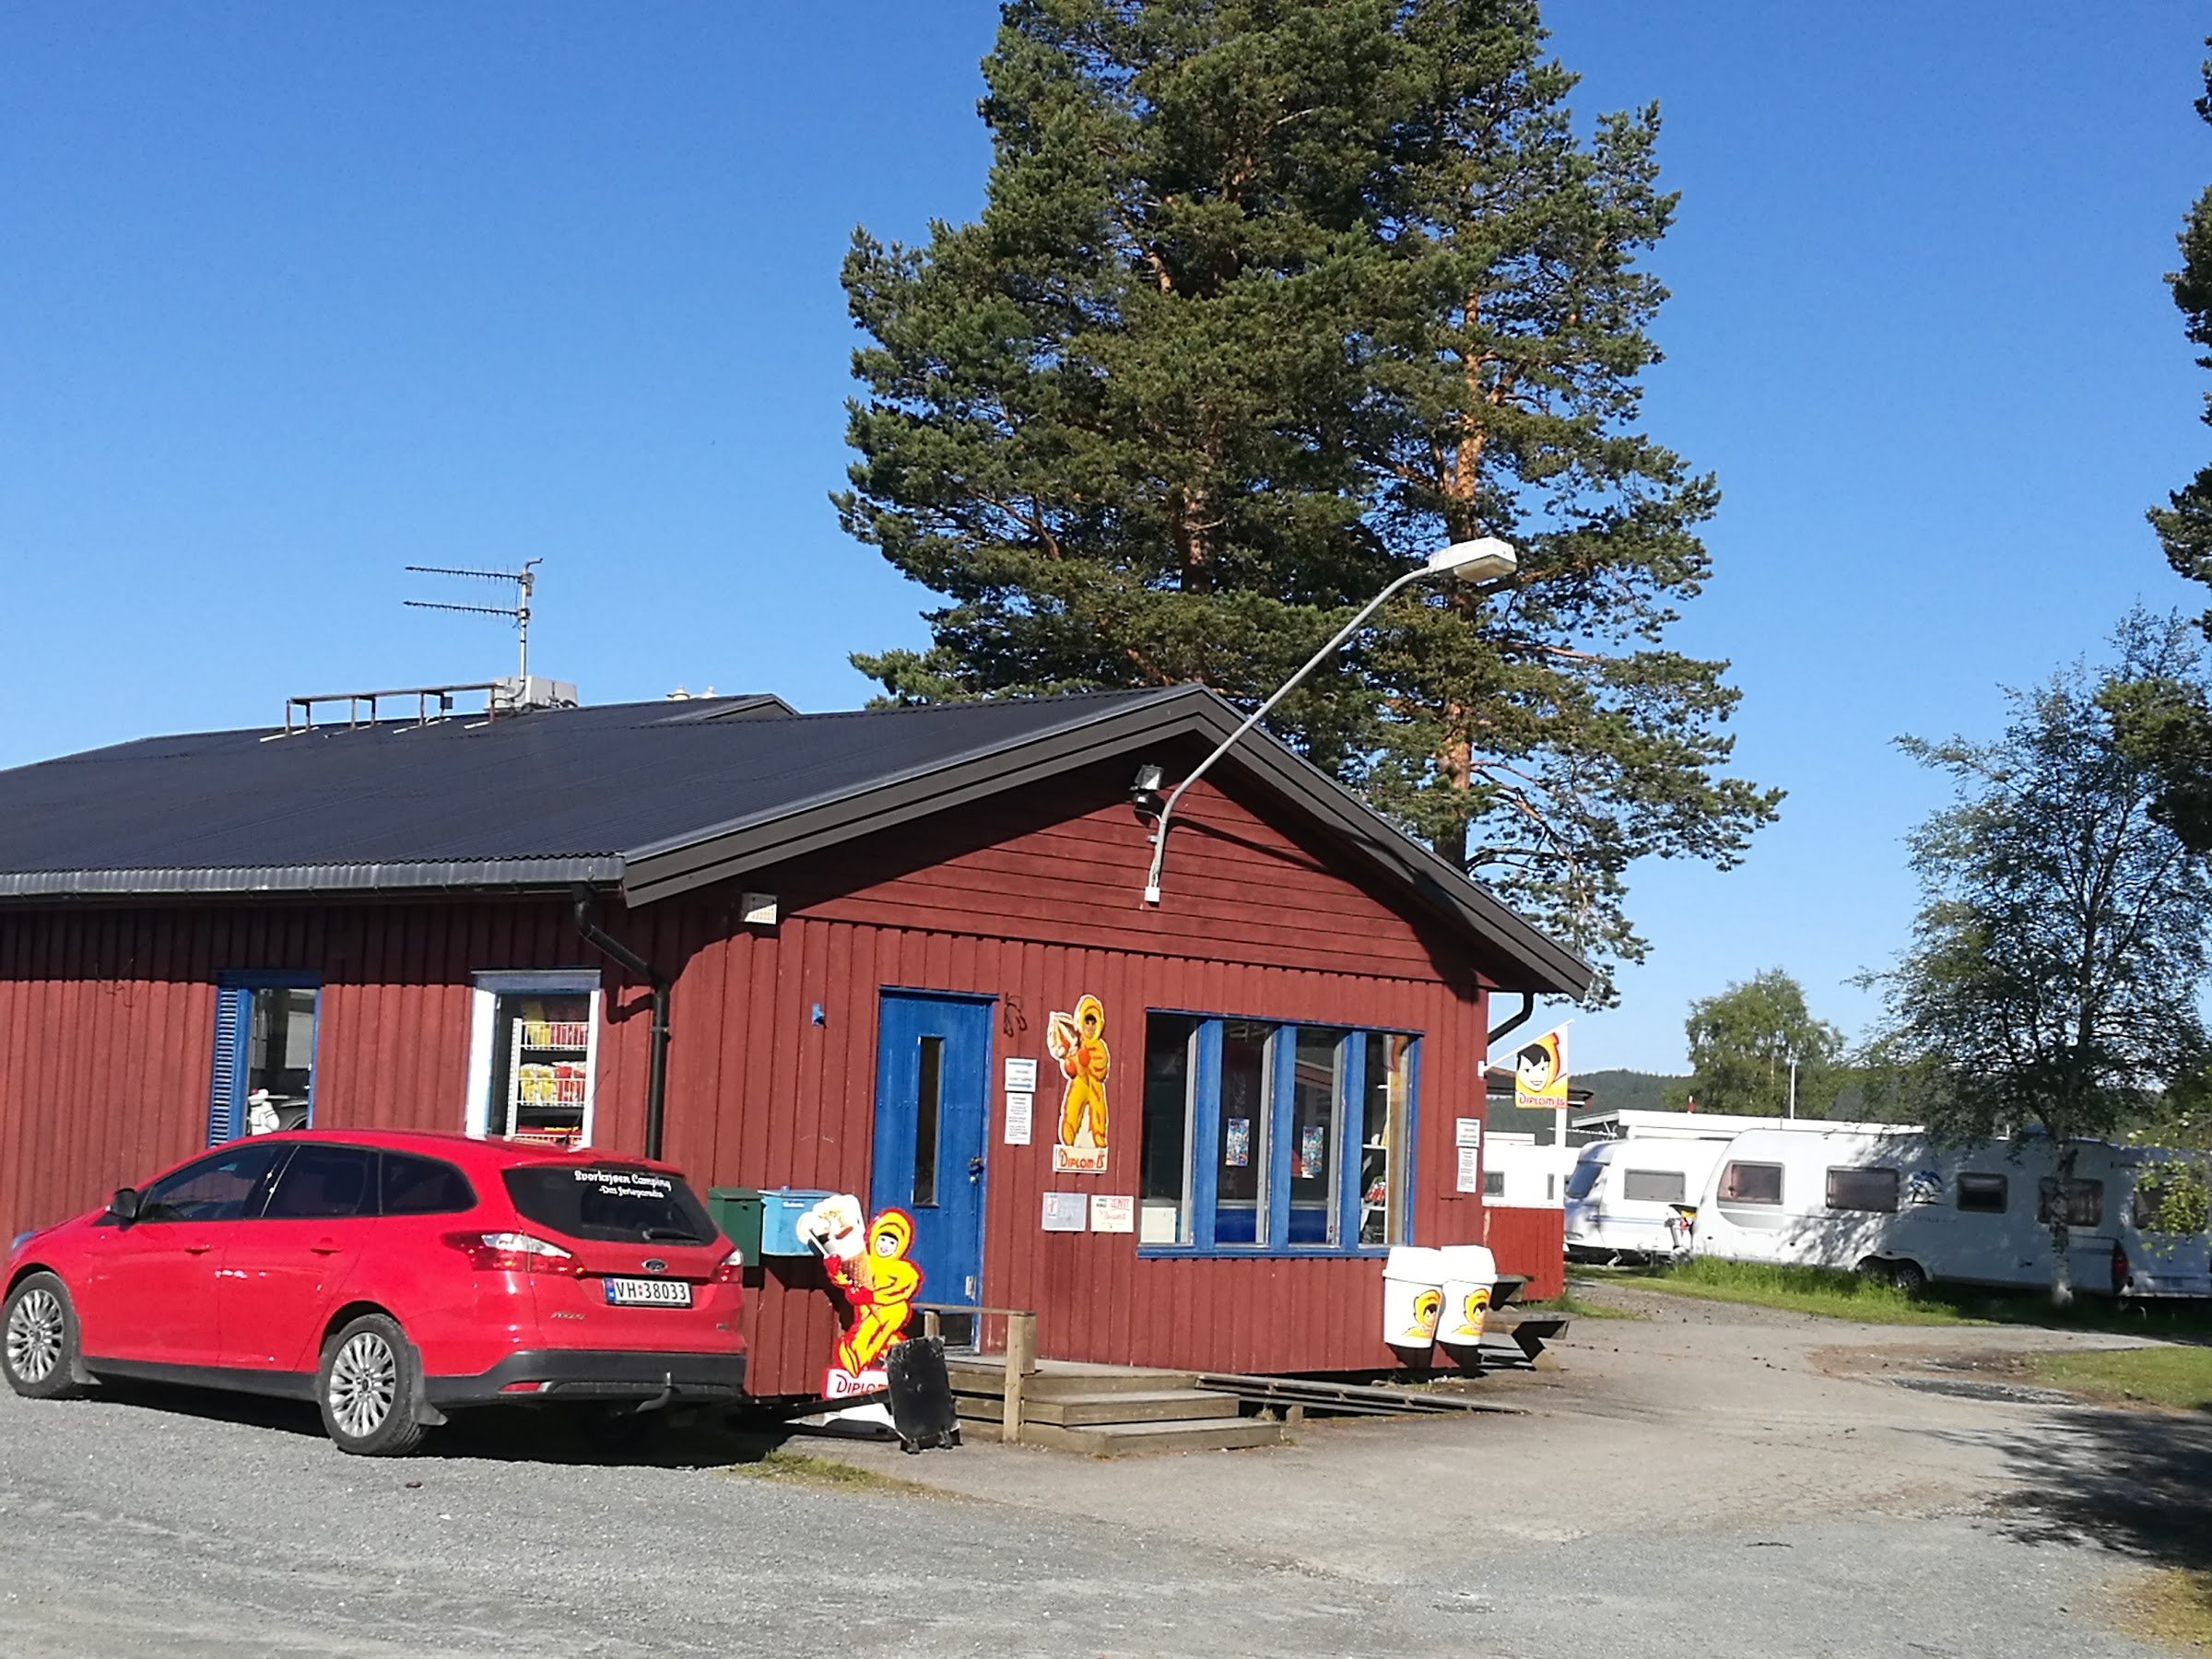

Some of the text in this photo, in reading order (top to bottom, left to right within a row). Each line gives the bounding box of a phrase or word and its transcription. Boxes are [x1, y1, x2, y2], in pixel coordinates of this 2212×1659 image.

[631, 1173, 671, 1192] Camping
[616, 1282, 687, 1301] VH 38033
